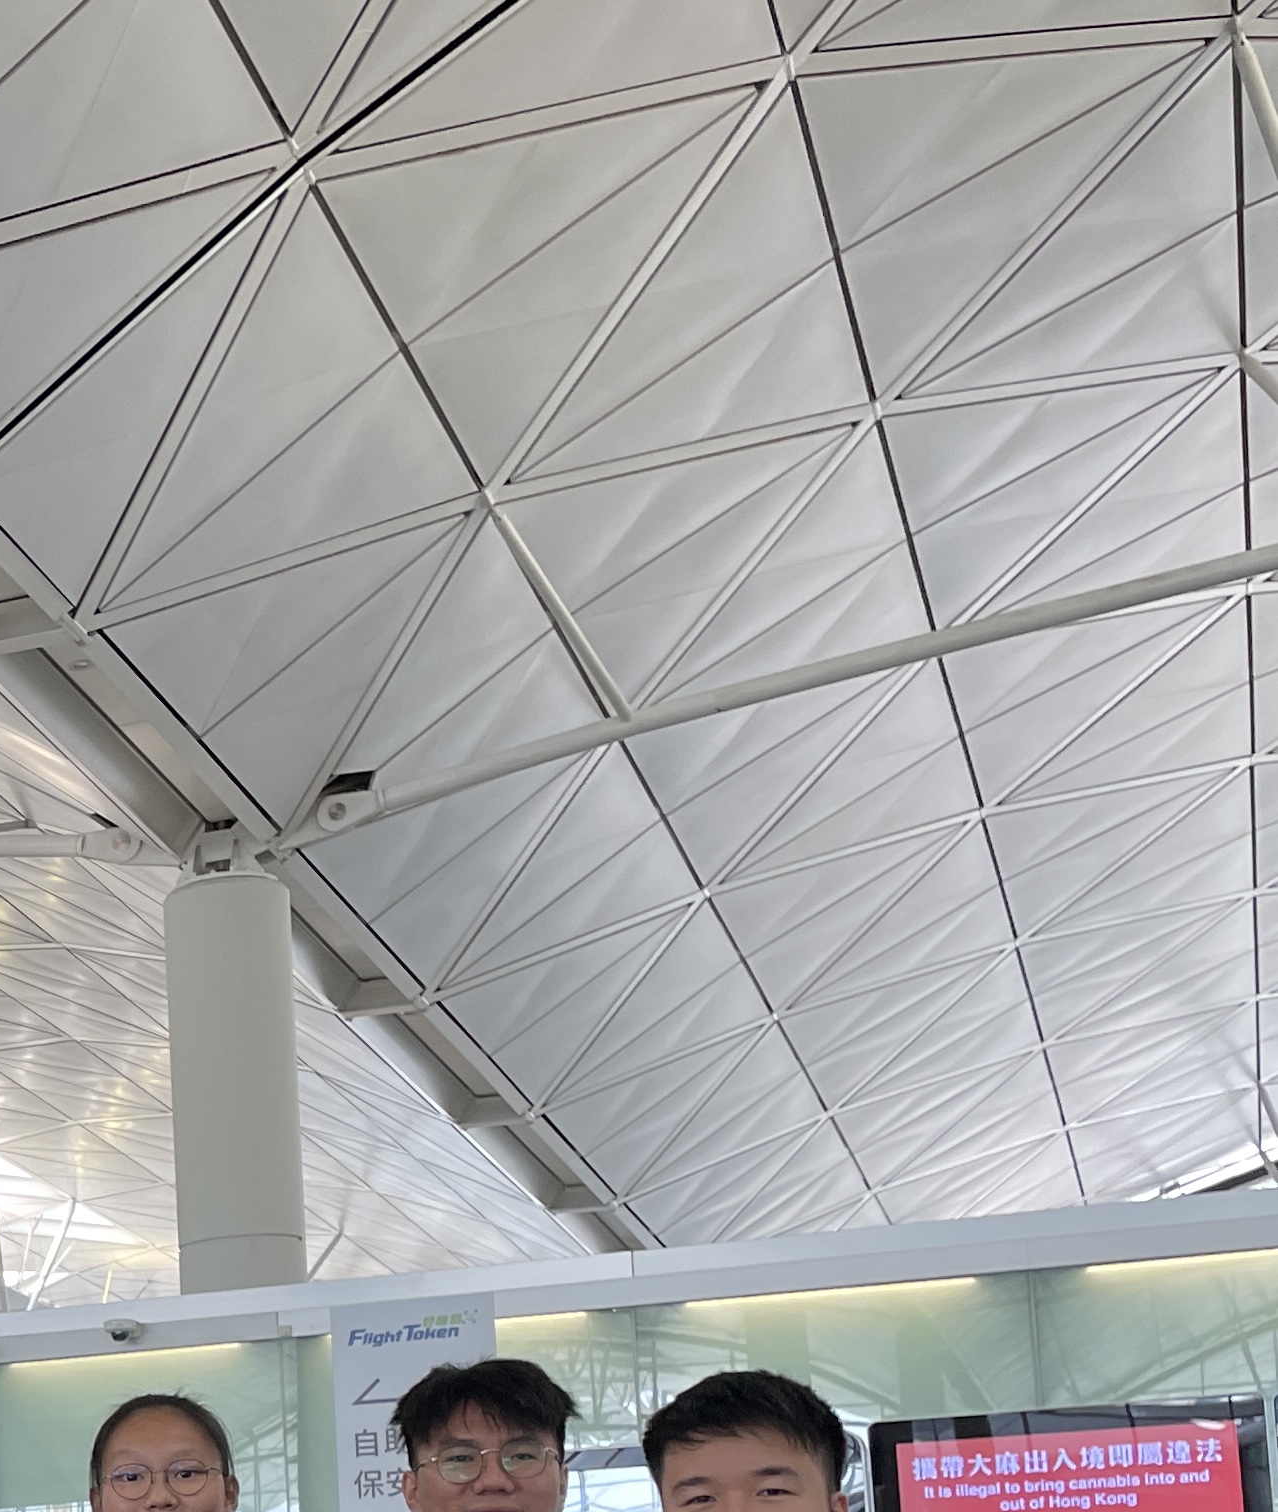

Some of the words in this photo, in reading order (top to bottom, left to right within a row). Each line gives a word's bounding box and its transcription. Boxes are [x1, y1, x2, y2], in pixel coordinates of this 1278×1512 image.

[956, 1482, 1000, 1498] illegal
[1005, 1482, 1020, 1494] to
[1024, 1480, 1065, 1494] bring
[1069, 1474, 1140, 1490] cannabis
[1145, 1471, 1175, 1486] into
[1180, 1468, 1210, 1483] and
[1000, 1497, 1026, 1511] out
[1029, 1496, 1044, 1510] of
[1049, 1495, 1091, 1510] Hong
[1095, 1492, 1138, 1507] Kong
